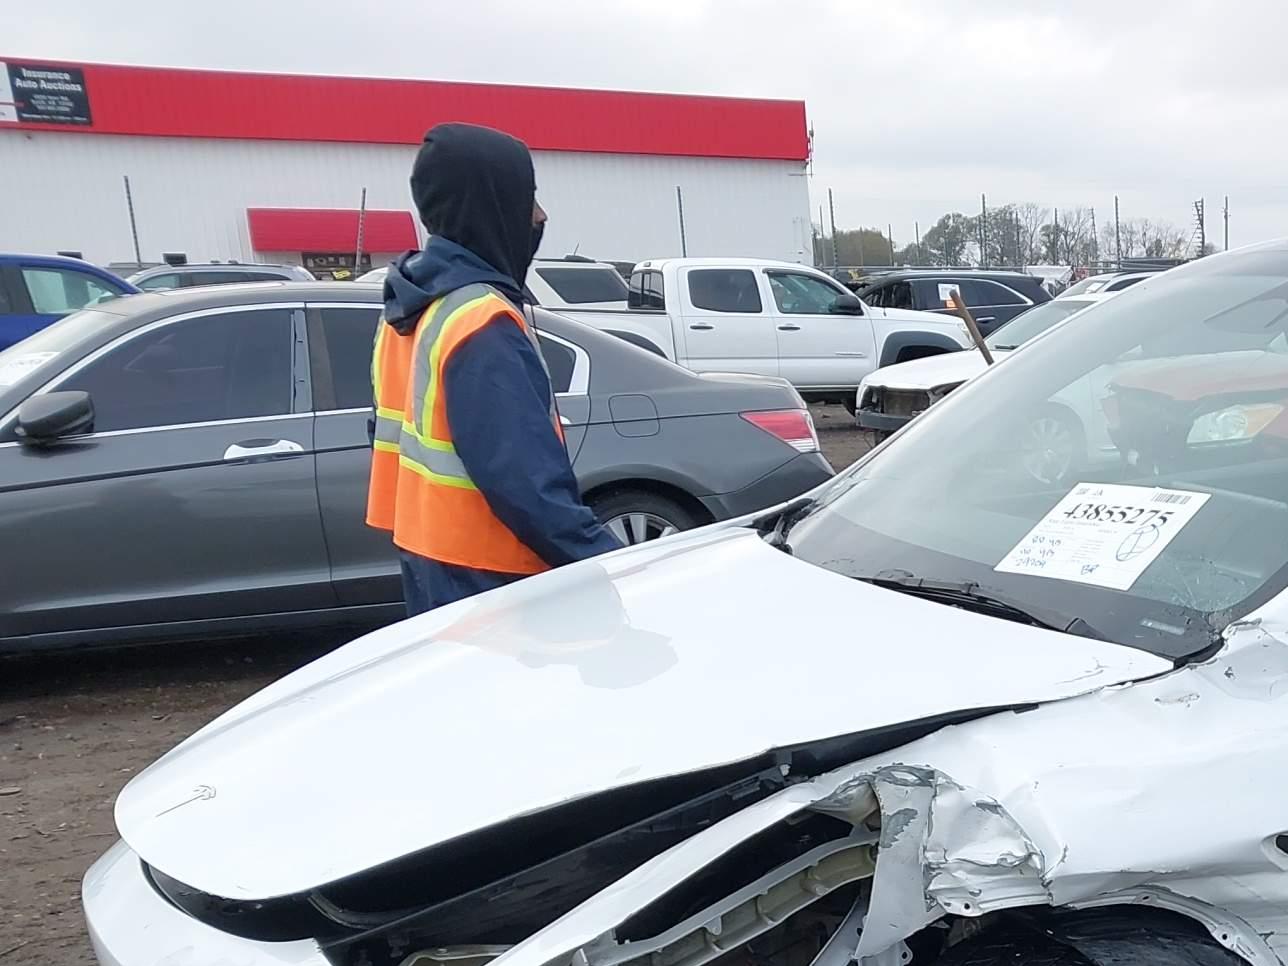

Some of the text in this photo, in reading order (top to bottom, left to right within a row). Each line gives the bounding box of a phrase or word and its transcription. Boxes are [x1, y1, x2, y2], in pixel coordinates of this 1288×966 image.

[21, 68, 71, 80] Insurance
[15, 77, 82, 91] Auto Auctions
[1063, 503, 1175, 527] 43855275
